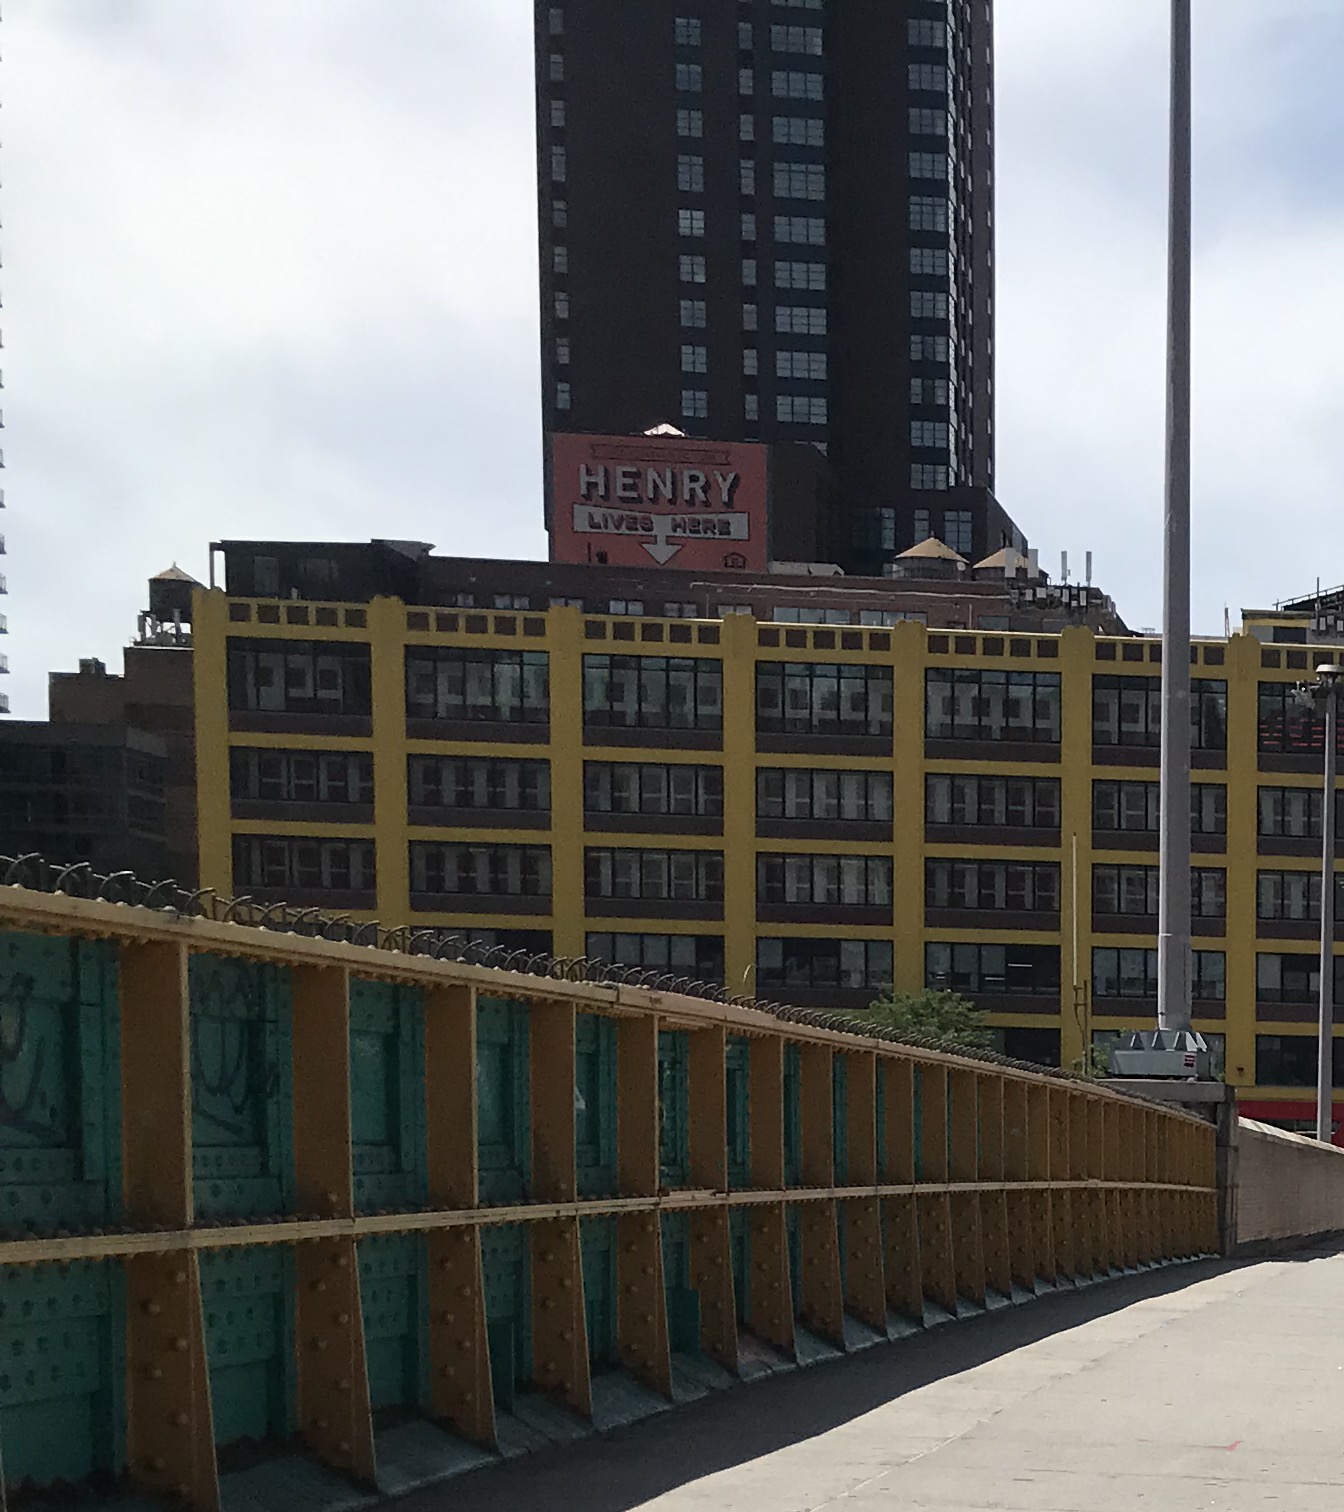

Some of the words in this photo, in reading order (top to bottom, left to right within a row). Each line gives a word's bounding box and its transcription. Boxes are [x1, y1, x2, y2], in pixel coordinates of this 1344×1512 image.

[579, 463, 739, 508] HENRY
[587, 511, 654, 533] LIVES
[671, 516, 731, 536] HERE
